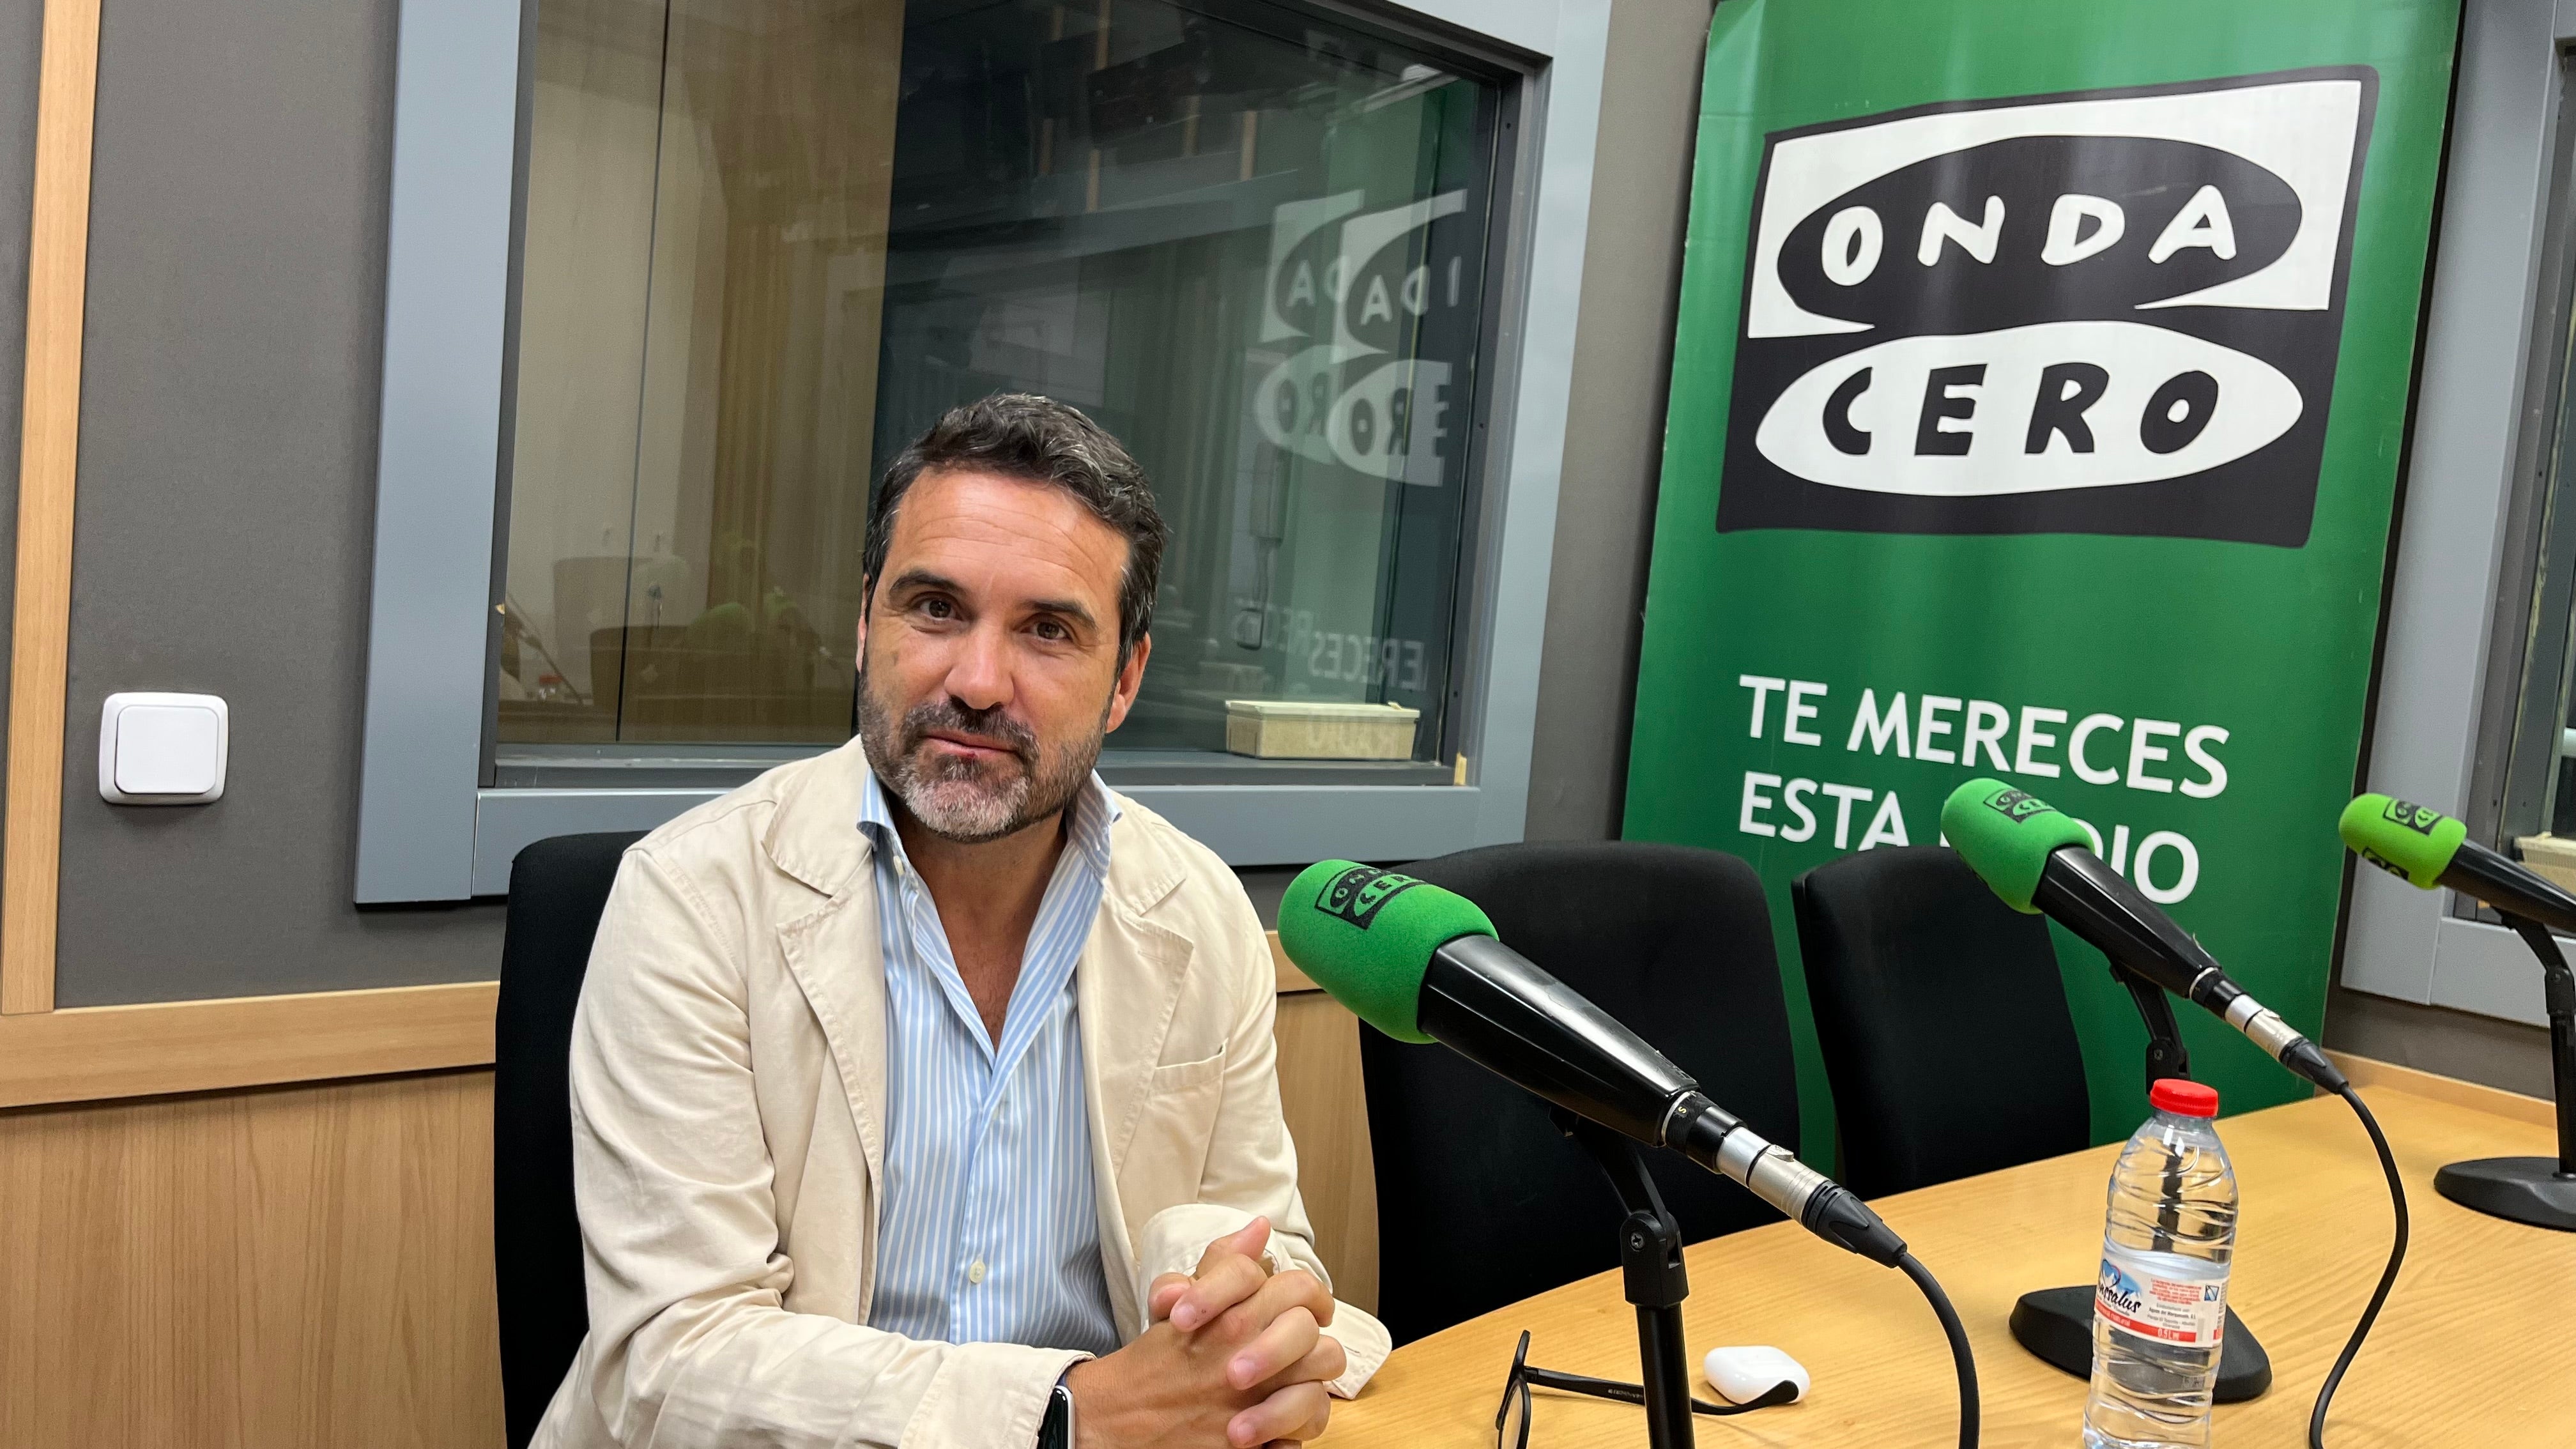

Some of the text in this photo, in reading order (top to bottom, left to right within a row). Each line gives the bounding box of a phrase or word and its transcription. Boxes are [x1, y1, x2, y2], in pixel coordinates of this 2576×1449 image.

[1821, 185, 2237, 286] ONDA
[1822, 362, 2219, 457] CERO
[1738, 675, 2230, 799] TE MERECES
[1739, 770, 1910, 852] ESTA
